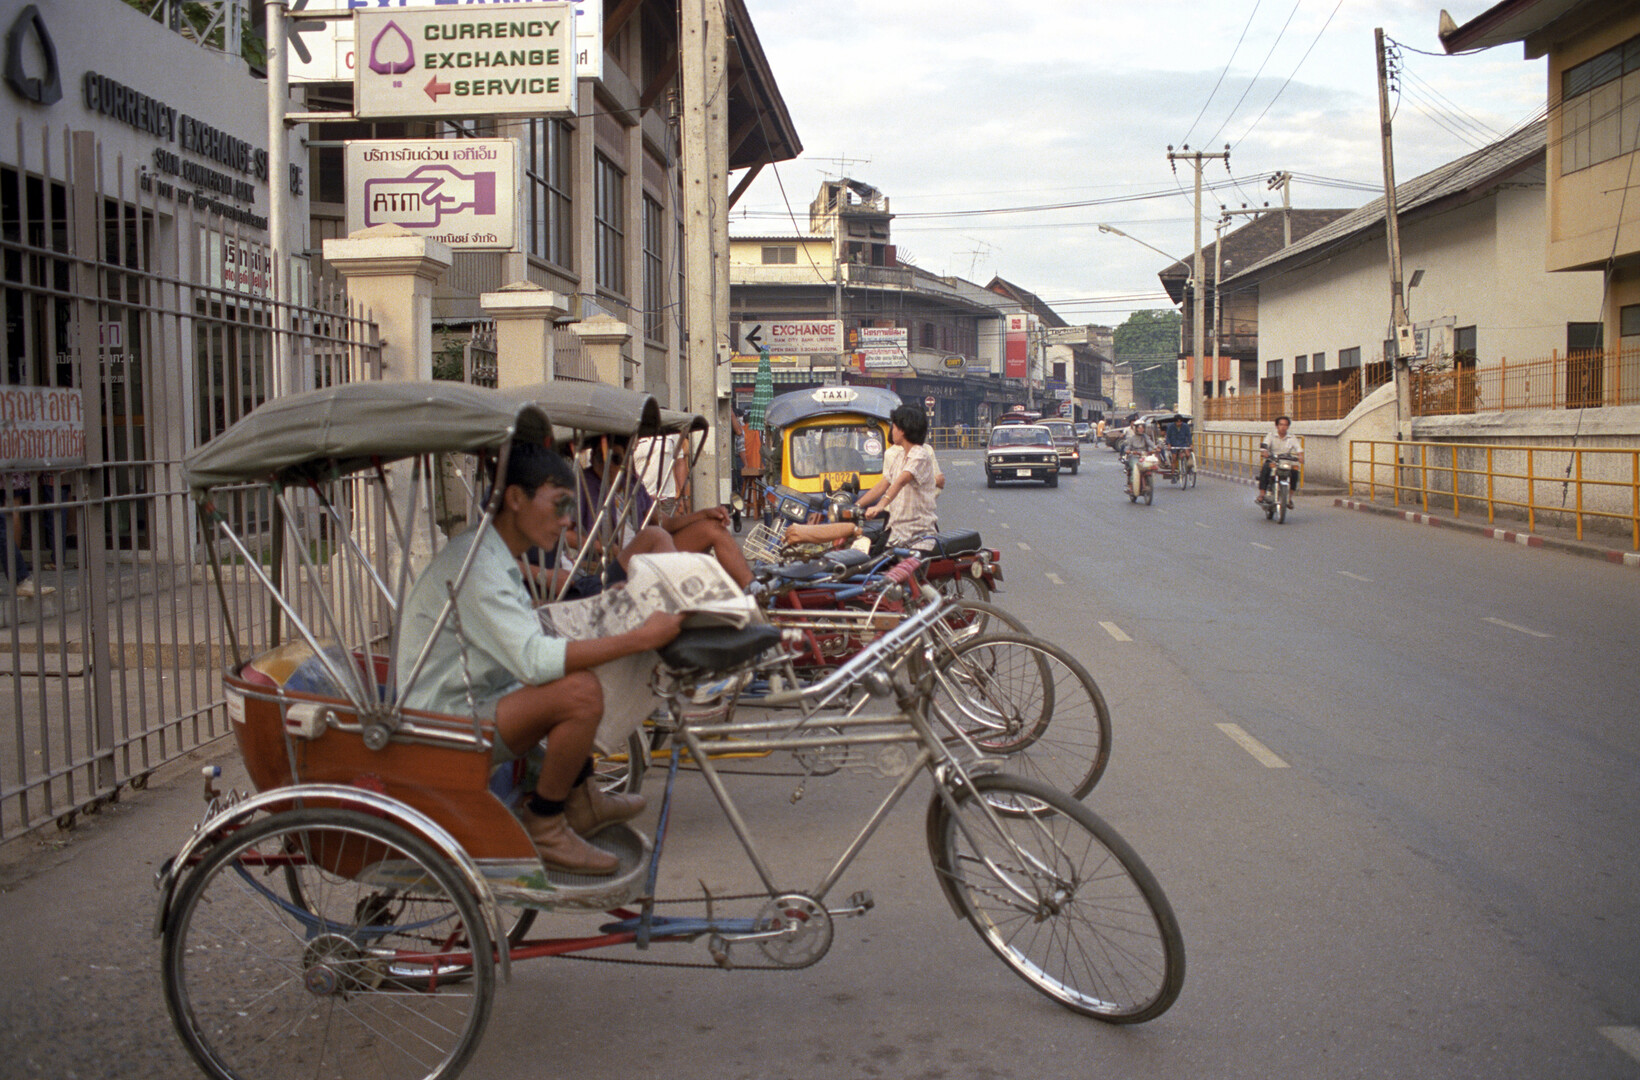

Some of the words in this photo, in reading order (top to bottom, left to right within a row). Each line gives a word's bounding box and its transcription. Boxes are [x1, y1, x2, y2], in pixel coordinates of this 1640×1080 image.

[424, 20, 560, 41] CURRENCY
[424, 48, 559, 69] EXCHANGE
[454, 77, 559, 96] SERVICE
[84, 70, 177, 142] CURRENCY
[181, 113, 253, 175] EXCHANGE
[155, 147, 179, 177] SIAM
[363, 146, 449, 162] บริการเงินด่วน
[453, 145, 498, 161] เอทีเอ็ม
[373, 193, 420, 212] ATM
[472, 232, 498, 243] จำกัด
[772, 324, 836, 336] EXCHANGE
